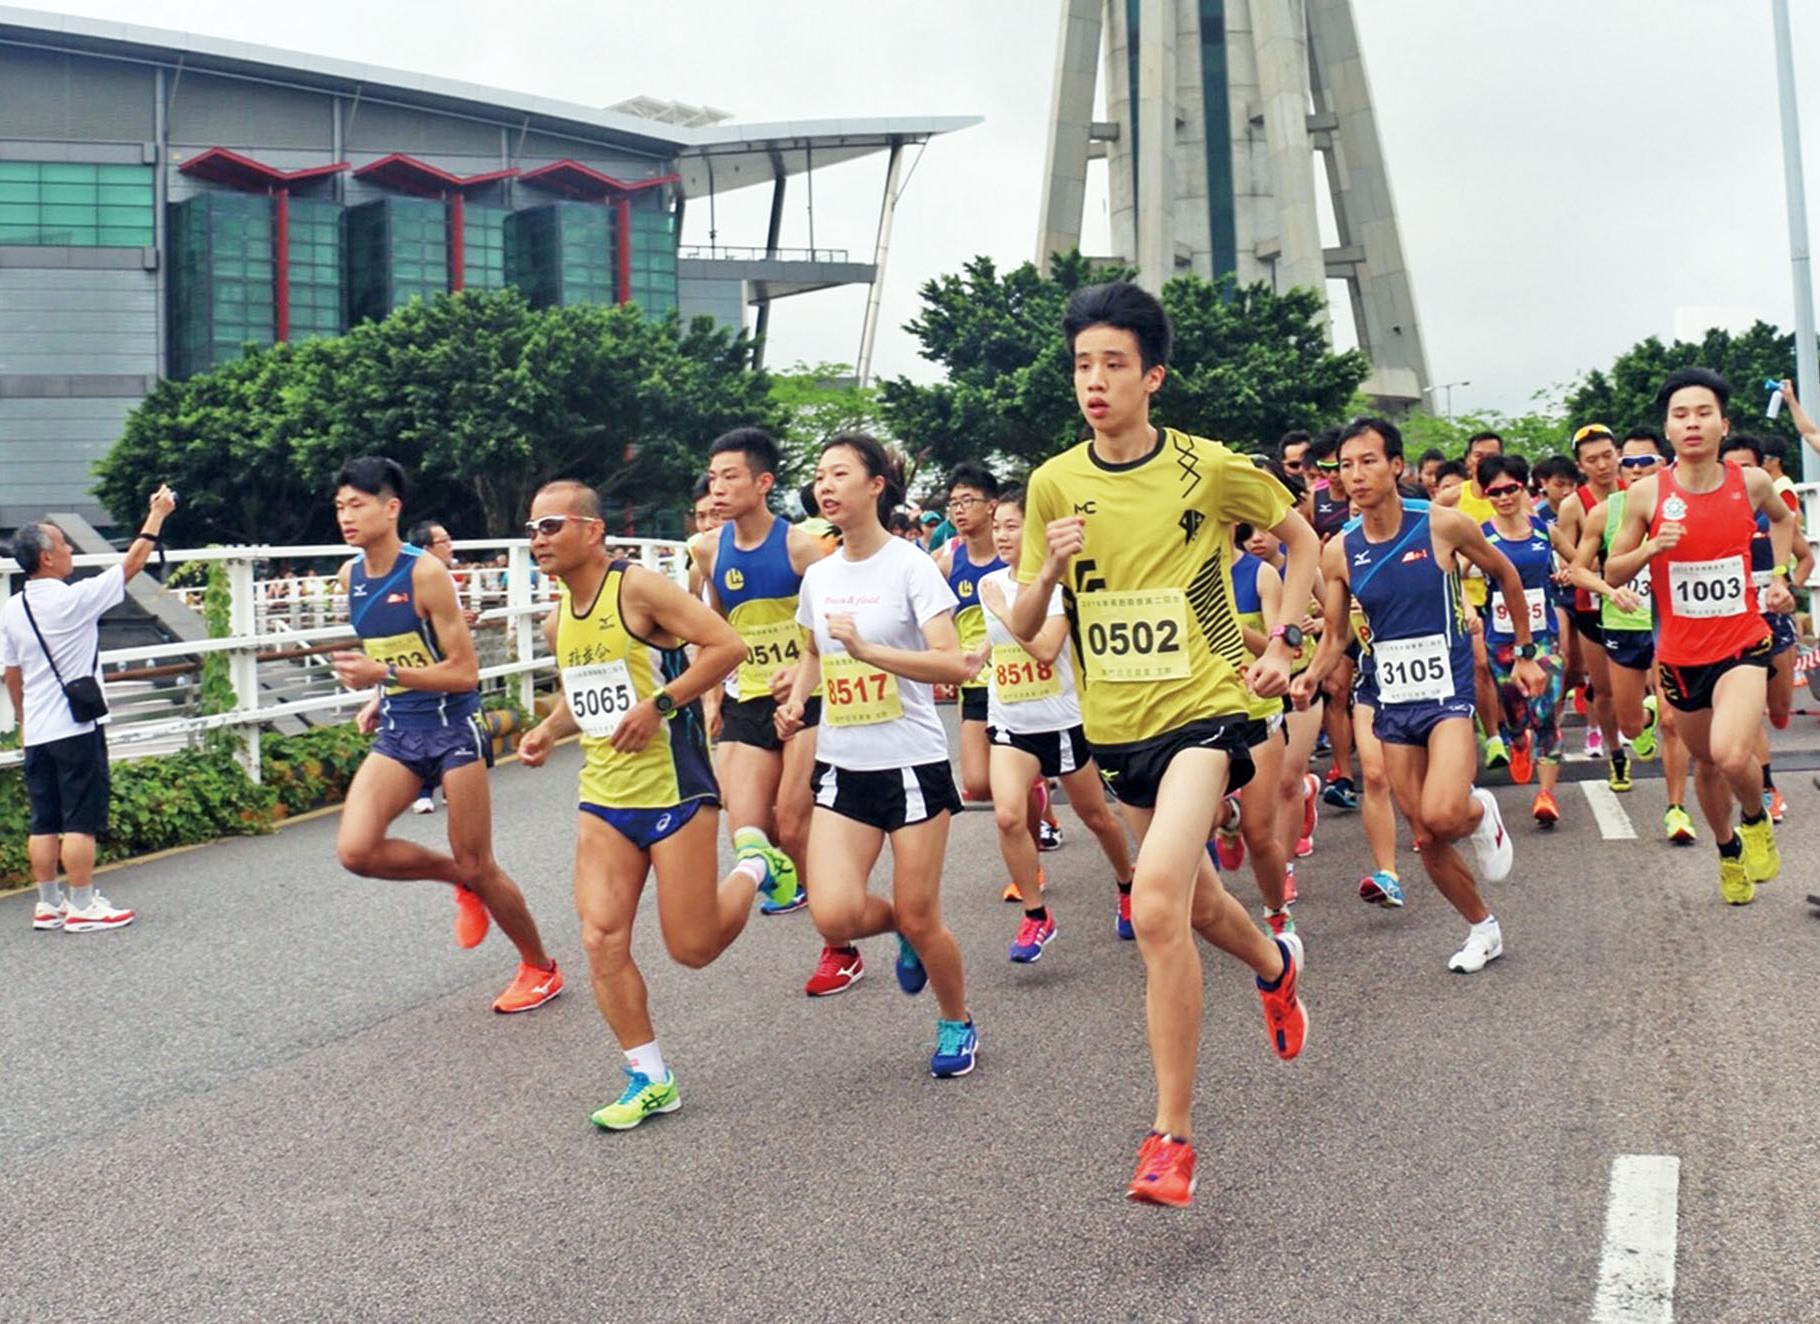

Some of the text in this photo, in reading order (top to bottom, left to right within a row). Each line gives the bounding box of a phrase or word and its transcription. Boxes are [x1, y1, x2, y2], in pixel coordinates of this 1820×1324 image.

[1074, 501, 1097, 515] MC
[1677, 577, 1741, 602] 1003
[1088, 619, 1179, 656] 0502
[996, 661, 1052, 687] 8518
[1382, 656, 1445, 685] 3105
[573, 684, 630, 718] 5065
[827, 673, 887, 705] 8517
